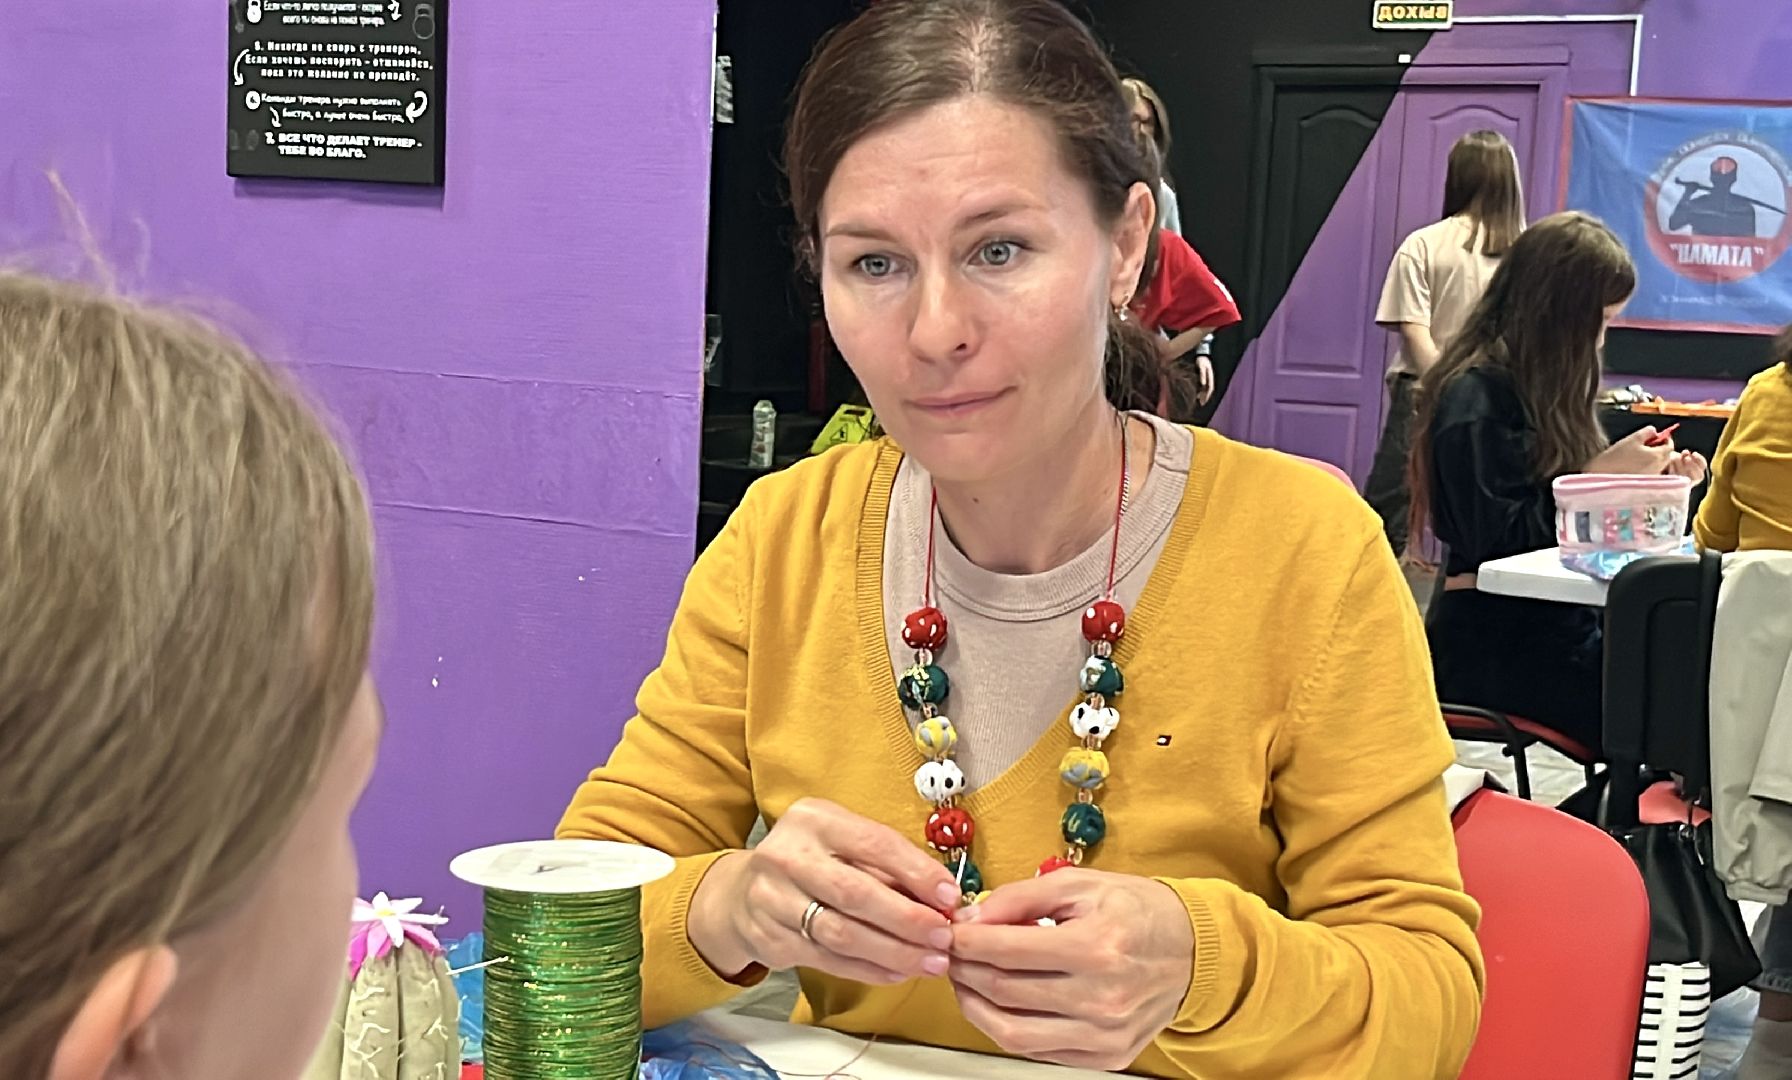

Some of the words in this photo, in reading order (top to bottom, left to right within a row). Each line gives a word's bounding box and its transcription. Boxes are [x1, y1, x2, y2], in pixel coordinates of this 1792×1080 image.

[267, 41, 308, 52] Никогда
[311, 43, 323, 52] не
[326, 43, 356, 54] спорь
[360, 44, 365, 52] с
[368, 44, 421, 55] тренером.
[245, 54, 268, 64] Если
[271, 56, 307, 65] хочешь
[310, 57, 362, 68] поспорить
[261, 68, 284, 77] пока
[287, 69, 304, 77] это
[307, 70, 349, 79] желание
[353, 71, 365, 80] не
[278, 133, 300, 143] ВСЕ
[302, 133, 325, 144] ЧТО
[326, 134, 371, 147] ДЕЛАЕТ
[372, 136, 416, 148] ТРЕНЕР
[278, 145, 307, 155] ТЕБЕ
[308, 146, 324, 157] ВО
[326, 147, 366, 158] БЛАГО.
